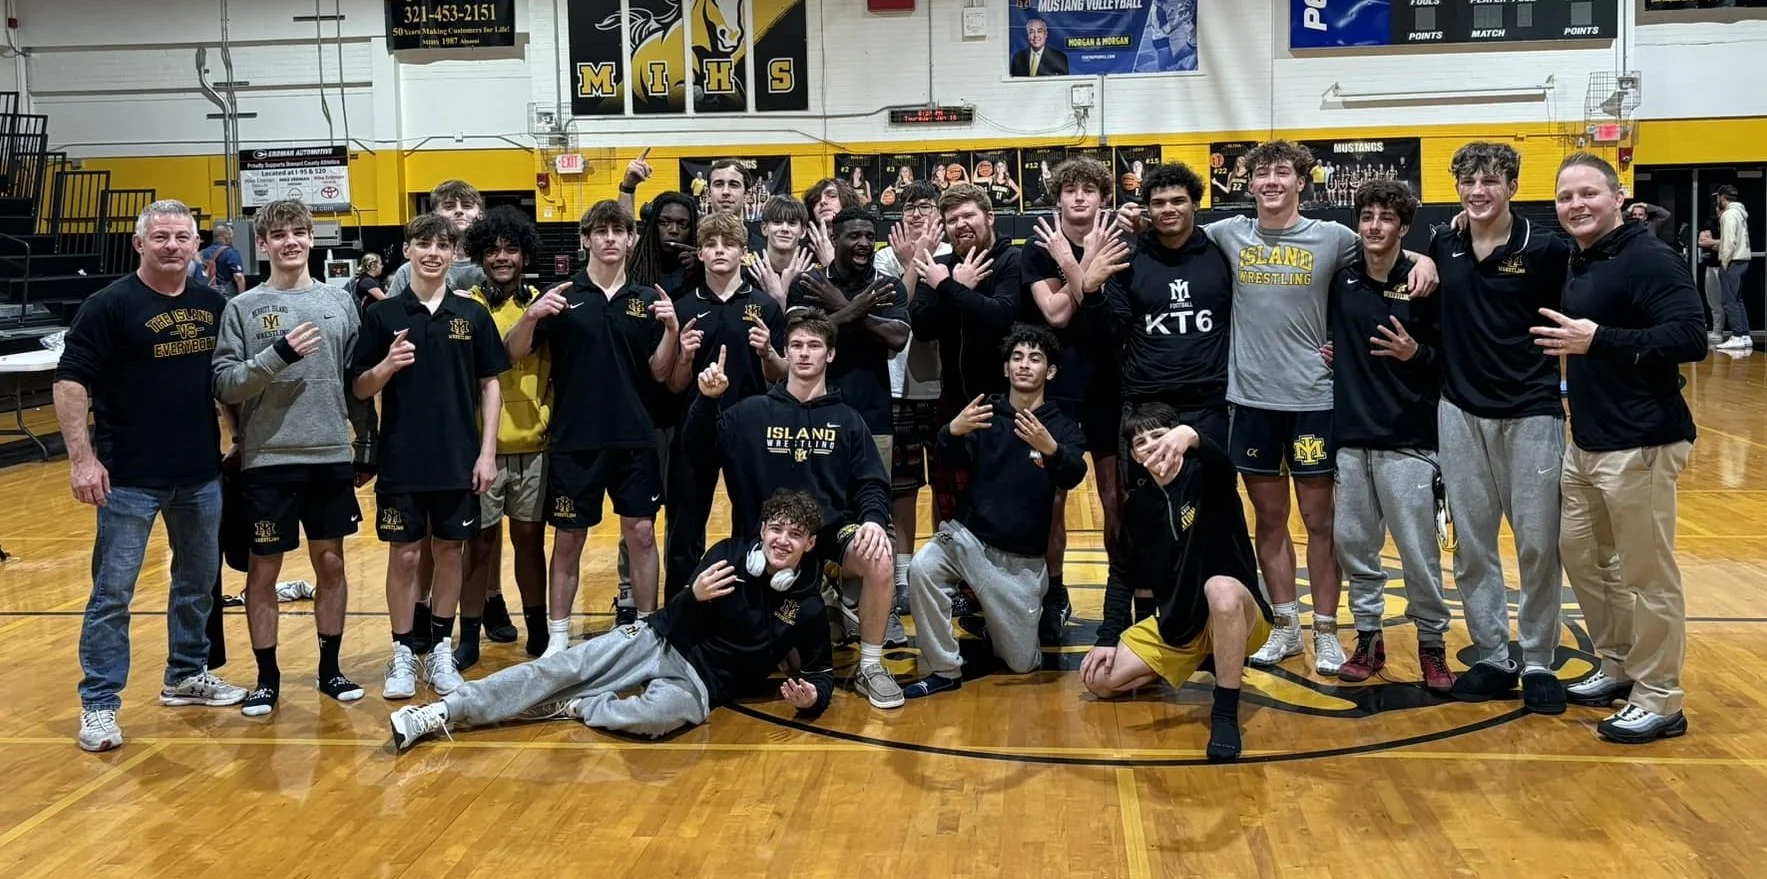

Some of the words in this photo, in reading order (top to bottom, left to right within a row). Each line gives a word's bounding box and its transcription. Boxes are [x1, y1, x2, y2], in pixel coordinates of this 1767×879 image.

[1037, 0, 1084, 13] MUSTANG
[1085, 0, 1143, 11] VOLLEYBALL
[403, 3, 497, 24] 321-453-2151
[392, 27, 404, 37] 50
[421, 27, 447, 36] Making
[448, 26, 481, 35] Customers
[1408, 31, 1443, 41] POINTS
[1471, 29, 1506, 38] MATCH
[1563, 26, 1600, 36] POINTS
[1068, 37, 1095, 47] MORGAN
[1095, 37, 1102, 46] &
[1102, 36, 1129, 46] MORGAN
[295, 148, 334, 157] AUTOMOTIVE
[1333, 142, 1384, 153] MUSTANGS
[560, 155, 578, 169] EXIT
[1024, 162, 1039, 170] #12
[1145, 158, 1160, 166] #15
[1213, 167, 1228, 175] #22
[1231, 182, 1243, 191] 22
[1239, 243, 1315, 272] ISLAND
[1238, 269, 1313, 287] WRESTLING
[1383, 290, 1410, 301] WRESTLIN
[271, 304, 289, 314] ISLAND
[1169, 301, 1193, 309] FOOTBALL
[144, 312, 175, 334] THE
[171, 308, 215, 326] ISLAND
[1144, 308, 1214, 336] KT6
[766, 426, 837, 442] ISLAND
[766, 438, 836, 450] WRESTLING
